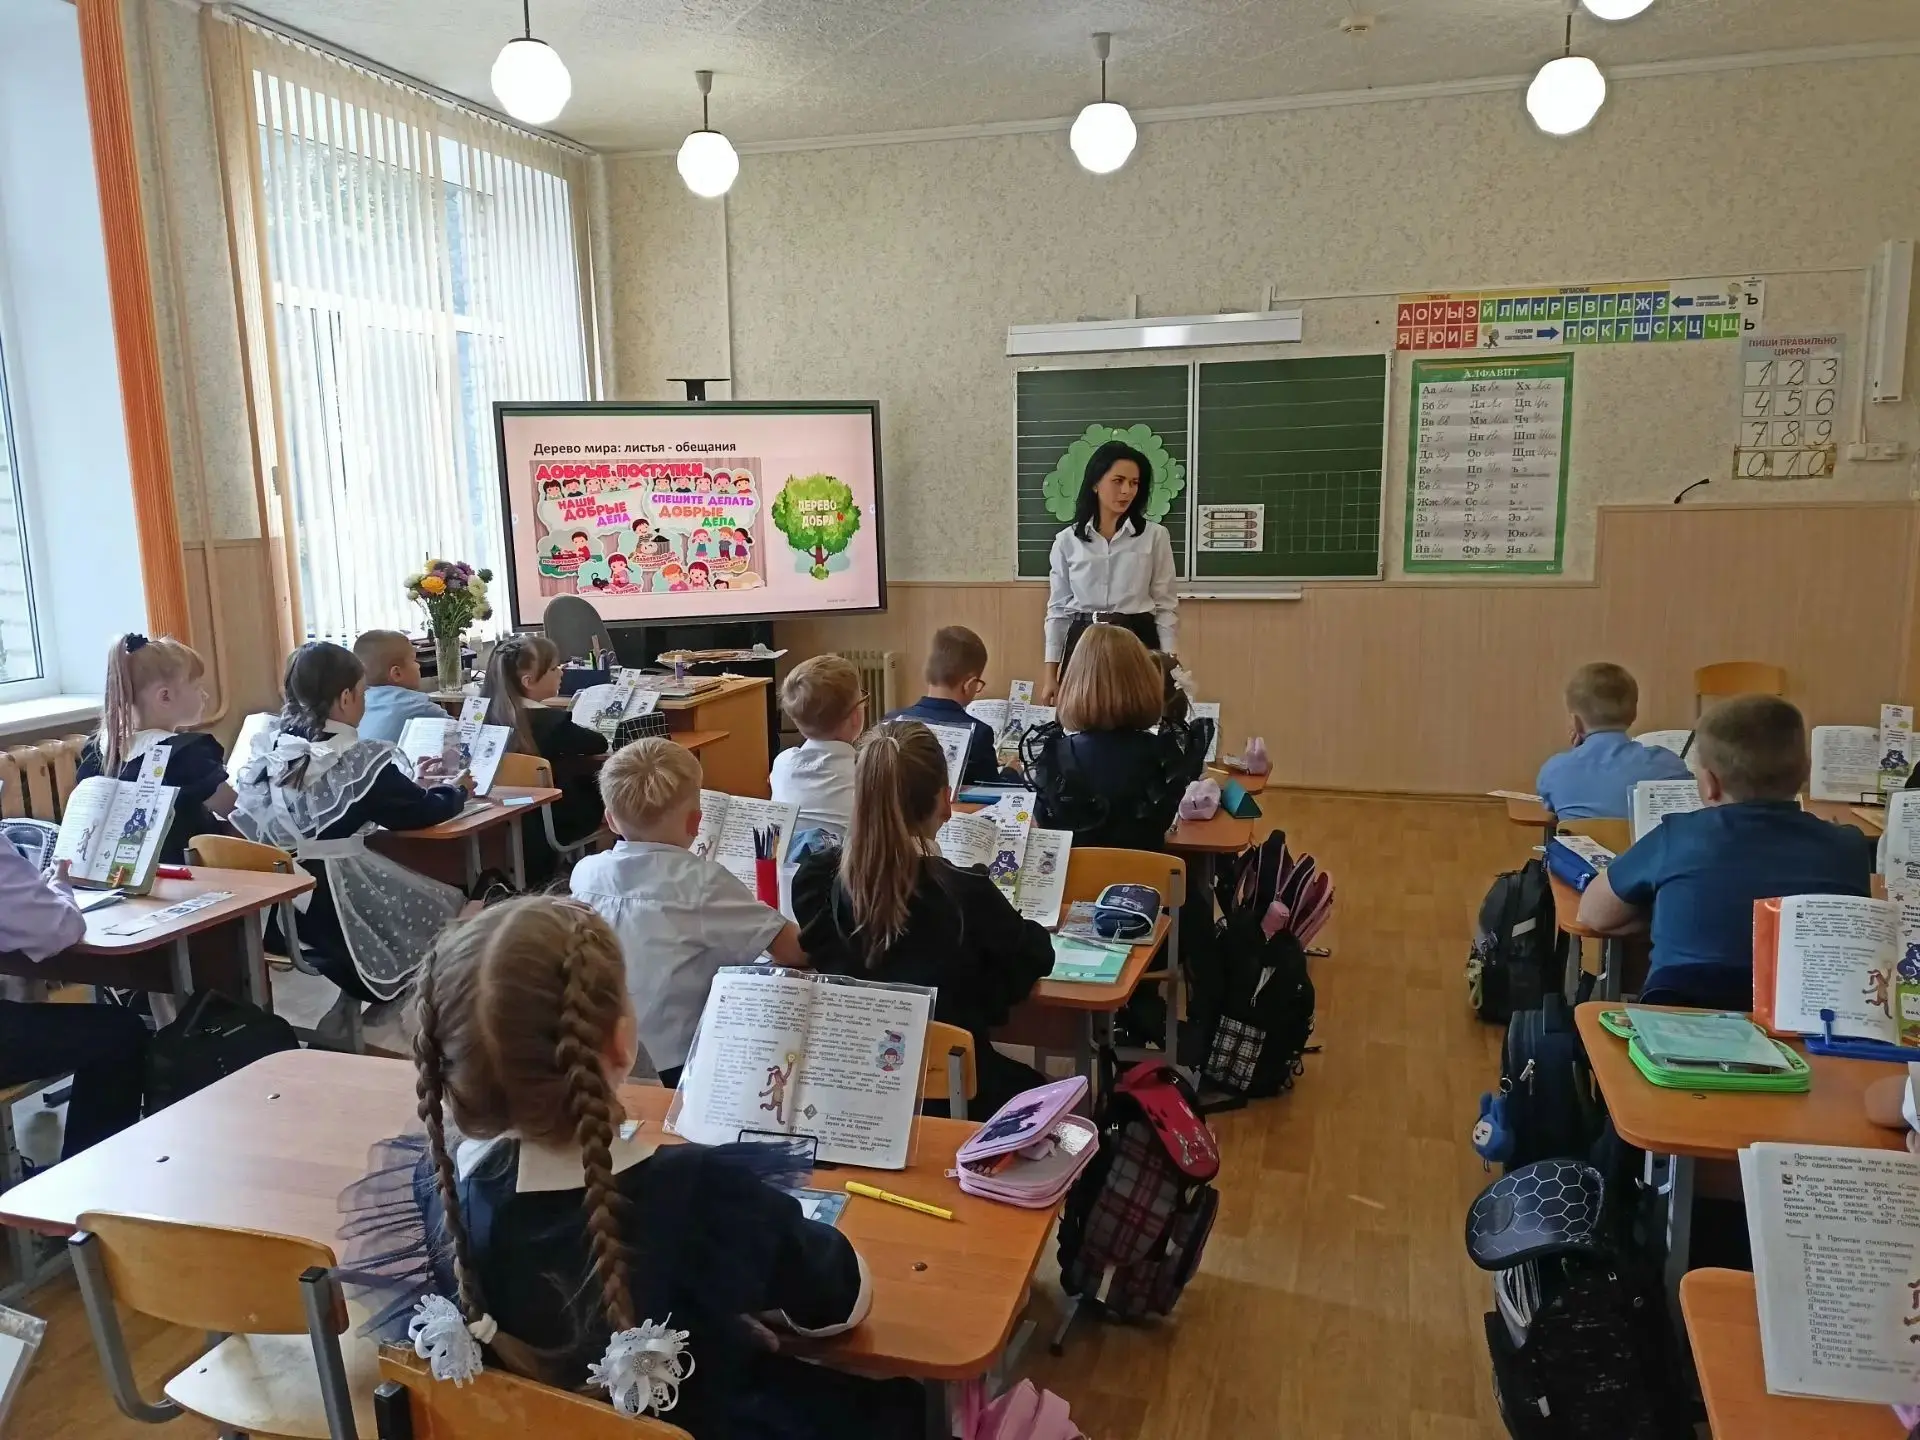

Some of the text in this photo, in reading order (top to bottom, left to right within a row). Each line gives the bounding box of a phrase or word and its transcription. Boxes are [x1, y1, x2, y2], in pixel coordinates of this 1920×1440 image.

[1744, 293, 1759, 305] Ъ
[1400, 297, 1665, 321] А О У Ы Э Й Л М Н Р Б В Г Д Ж З
[1566, 318, 1740, 338] П Ф К Т Ш С Х Ц Ч Щ
[1744, 318, 1755, 330] Ь
[1399, 328, 1475, 345] Я Ё Ю И Е
[1749, 336, 1837, 348] ПИШИ ПРАВИЛЬНО
[1774, 347, 1811, 357] ЦИФРЫ
[1463, 367, 1520, 379] АЛФАВИТ
[1760, 357, 1838, 386] 1 2 3
[1755, 388, 1835, 417] 4 5 6
[1751, 419, 1832, 447] 7 8 9
[533, 442, 582, 456] Дерево
[584, 443, 621, 456] мира:
[624, 442, 665, 453] листья
[675, 442, 736, 453] обещания
[1747, 450, 1828, 477] 0 10
[536, 463, 704, 480] ДОБРЫЕ ПОСТУПКИ
[557, 496, 596, 510] НАШИ
[652, 493, 754, 506] СПЕШИТЕ ДЕЛАТЬ
[798, 499, 837, 514] ДЕРЕВО
[563, 501, 627, 522] ДОБРЫЕ
[658, 505, 724, 518] ДОБРЫЕ
[596, 514, 631, 527] ДЕЛА
[702, 517, 736, 527] ДЕЛА
[801, 515, 835, 529] ДОБРА
[807, 1106, 815, 1117] 2
